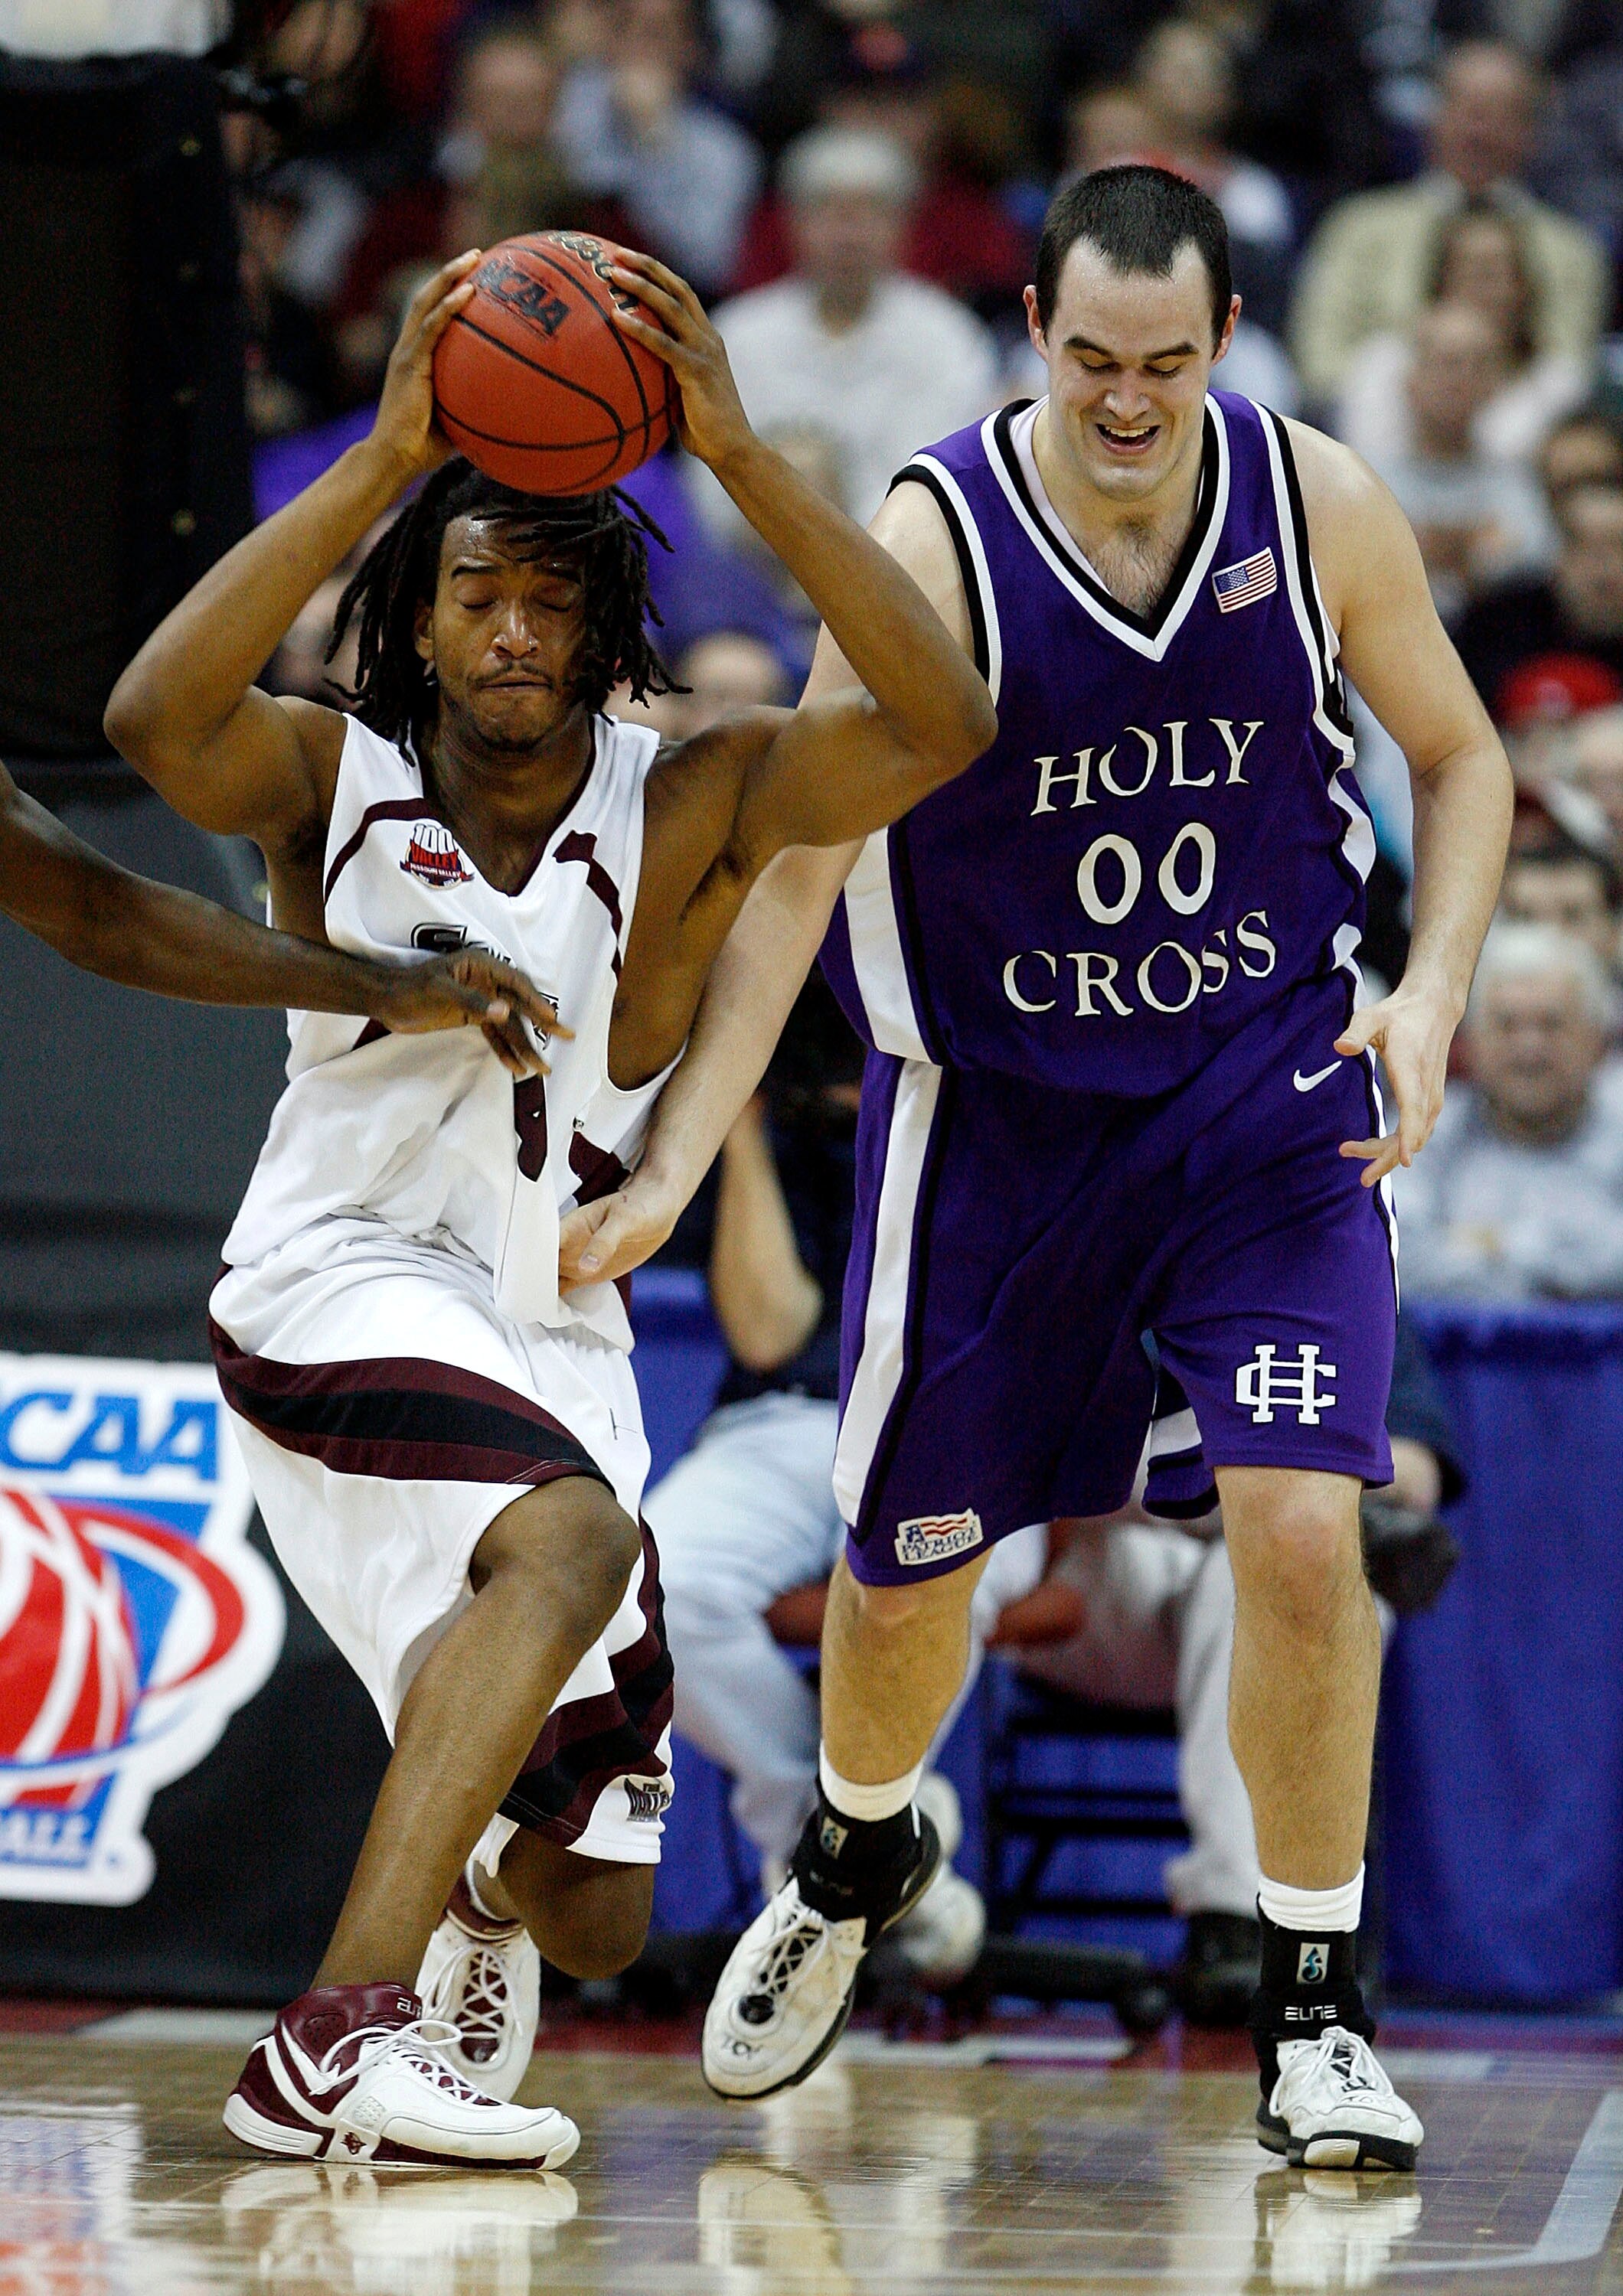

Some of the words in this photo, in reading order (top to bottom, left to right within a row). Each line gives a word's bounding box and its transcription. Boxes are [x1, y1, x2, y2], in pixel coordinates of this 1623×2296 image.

[1030, 719, 1264, 816] HOLY
[410, 840, 459, 871] VALLEY
[413, 823, 456, 854] 100
[1077, 823, 1216, 925] 00
[1003, 911, 1276, 1016] CROSS
[1285, 2004, 1338, 2020] ELITE
